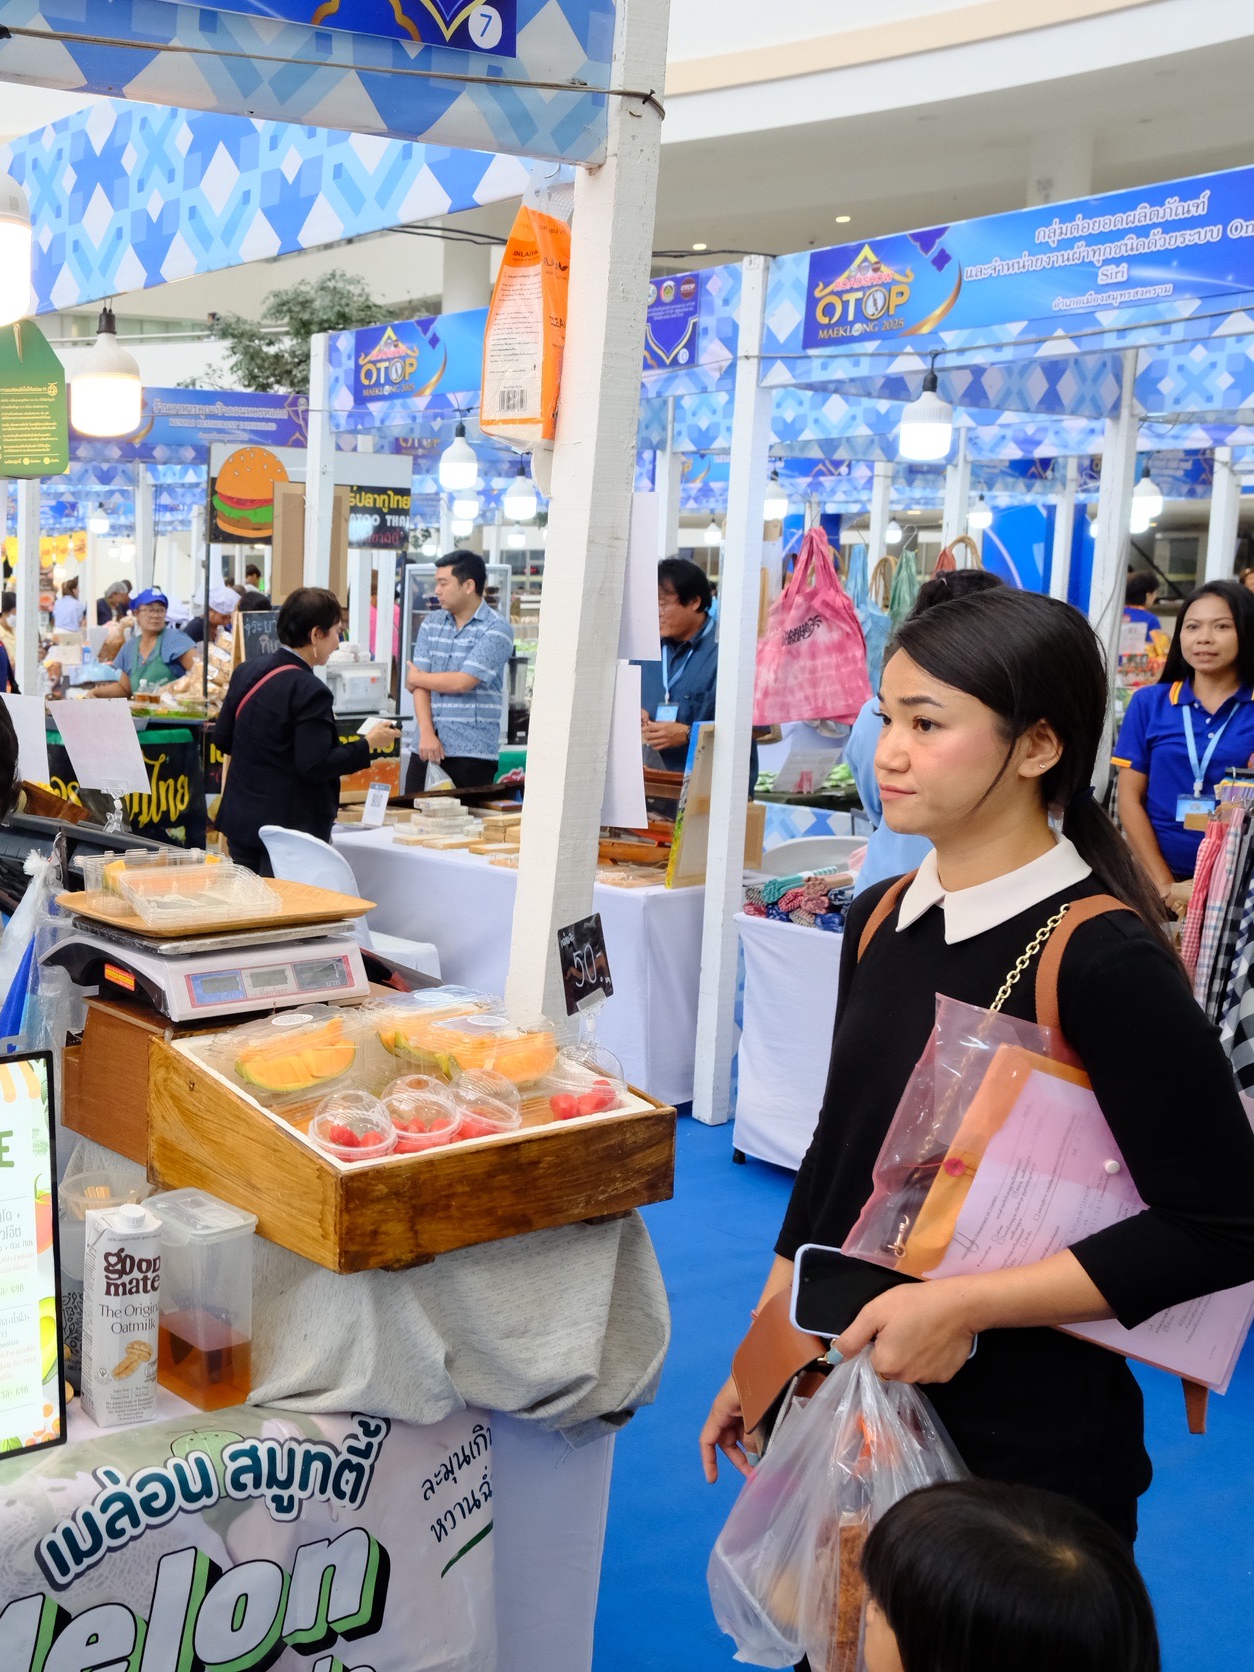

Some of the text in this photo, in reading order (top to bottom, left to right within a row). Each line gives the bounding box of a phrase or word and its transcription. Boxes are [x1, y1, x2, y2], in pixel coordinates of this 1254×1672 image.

[478, 13, 493, 38] 7
[833, 271, 895, 291] ROADSHOW
[1097, 263, 1128, 284] Siri
[816, 284, 910, 325] OTOP
[882, 318, 905, 331] 2025
[360, 357, 418, 386] OTOP
[104, 1274, 161, 1297] mate
[99, 1298, 160, 1319] The Origin
[111, 1318, 156, 1335] Oatmilk
[41, 1414, 387, 1584] เมล่อน สมูทตี้
